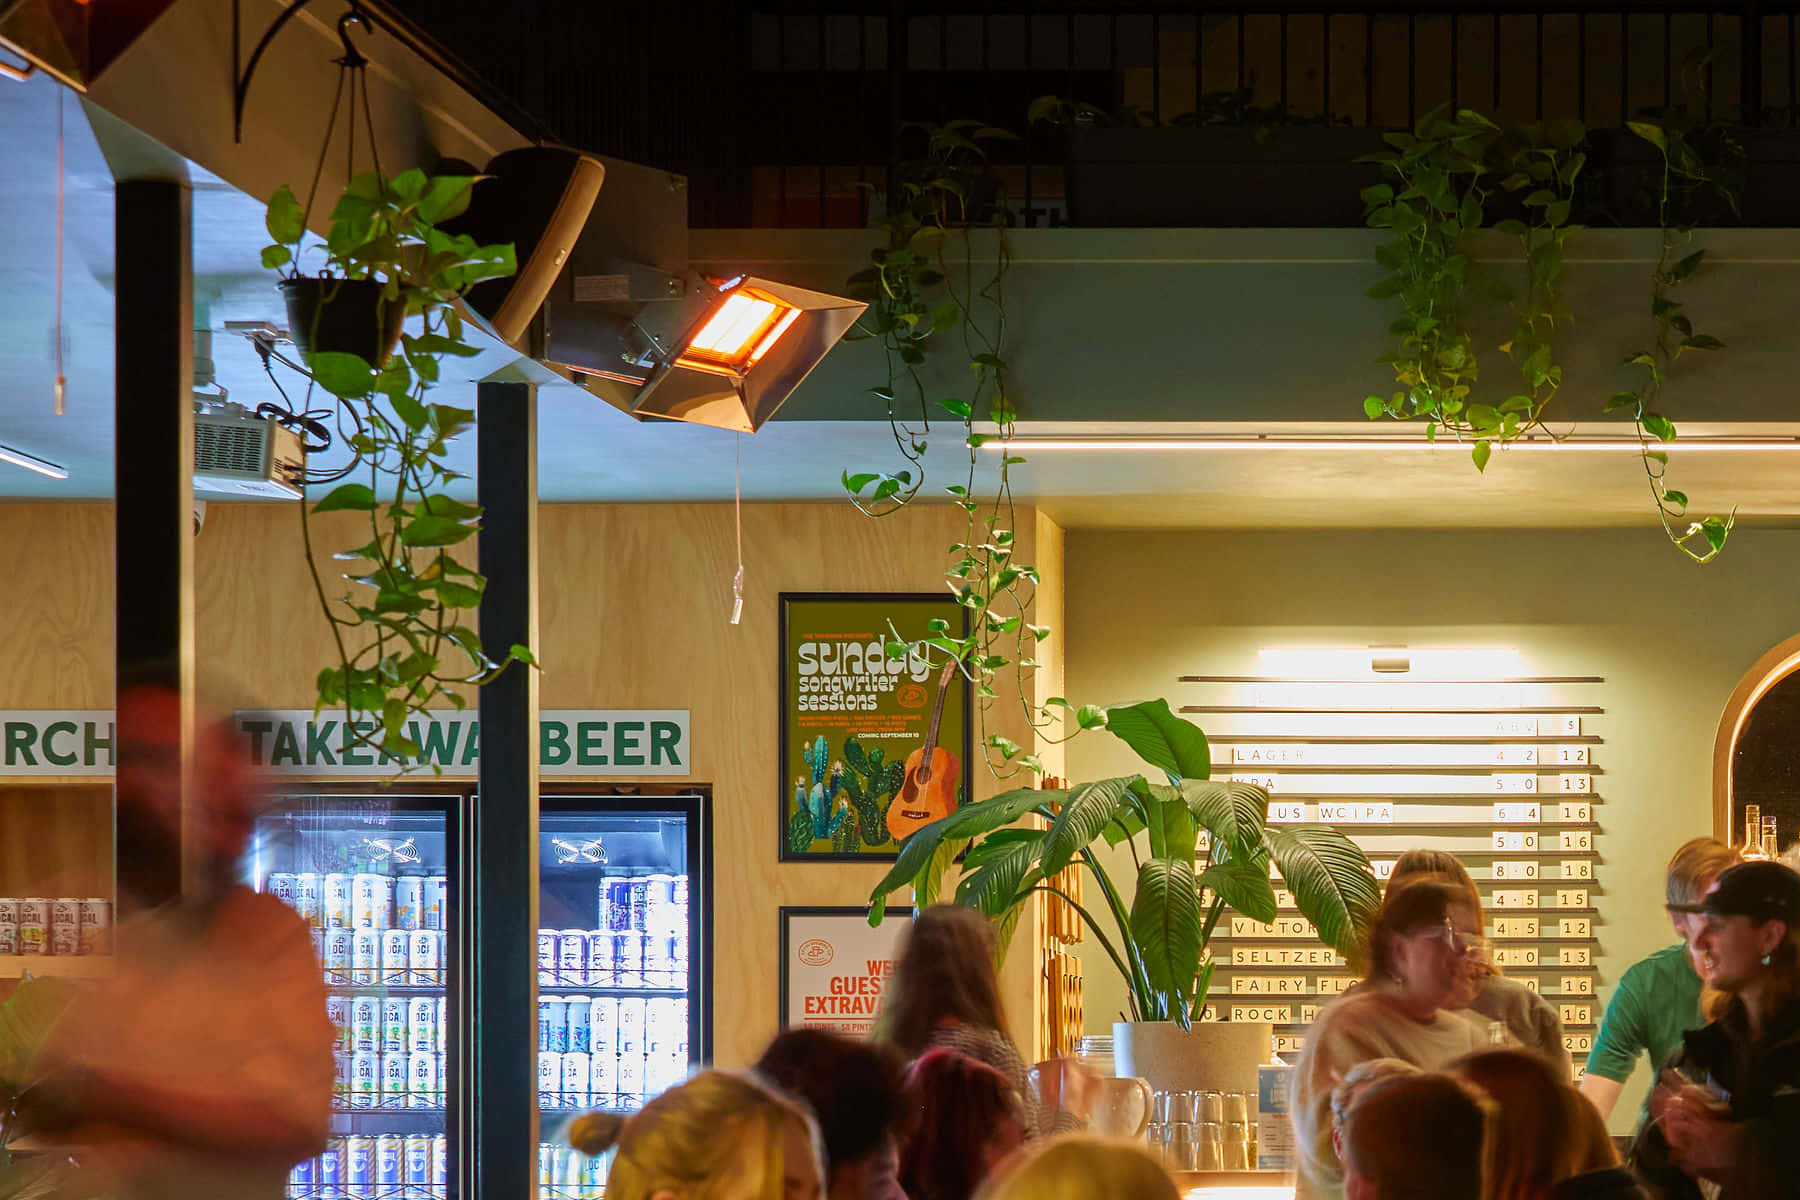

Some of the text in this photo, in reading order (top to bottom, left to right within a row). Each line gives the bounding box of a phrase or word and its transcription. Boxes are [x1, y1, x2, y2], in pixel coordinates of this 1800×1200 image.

[798, 634, 930, 682] sunday
[799, 672, 898, 696] songwriter
[798, 691, 878, 711] sessions
[539, 721, 682, 766] BEER
[1237, 749, 1305, 761] LAGER
[1563, 750, 1584, 761] 12
[1565, 778, 1586, 790] 13
[1565, 807, 1586, 819] 16
[1566, 836, 1587, 848] 16
[1566, 865, 1588, 876] 18
[1562, 894, 1583, 905] 15
[1564, 923, 1586, 934] 12
[1236, 951, 1332, 963] SELTZER
[1564, 952, 1586, 963] 13
[1236, 980, 1303, 991] FAIRY
[1566, 981, 1587, 991] 16
[1235, 1009, 1288, 1020] ROCK
[1564, 1009, 1586, 1020] 16
[1566, 1038, 1588, 1049] 20
